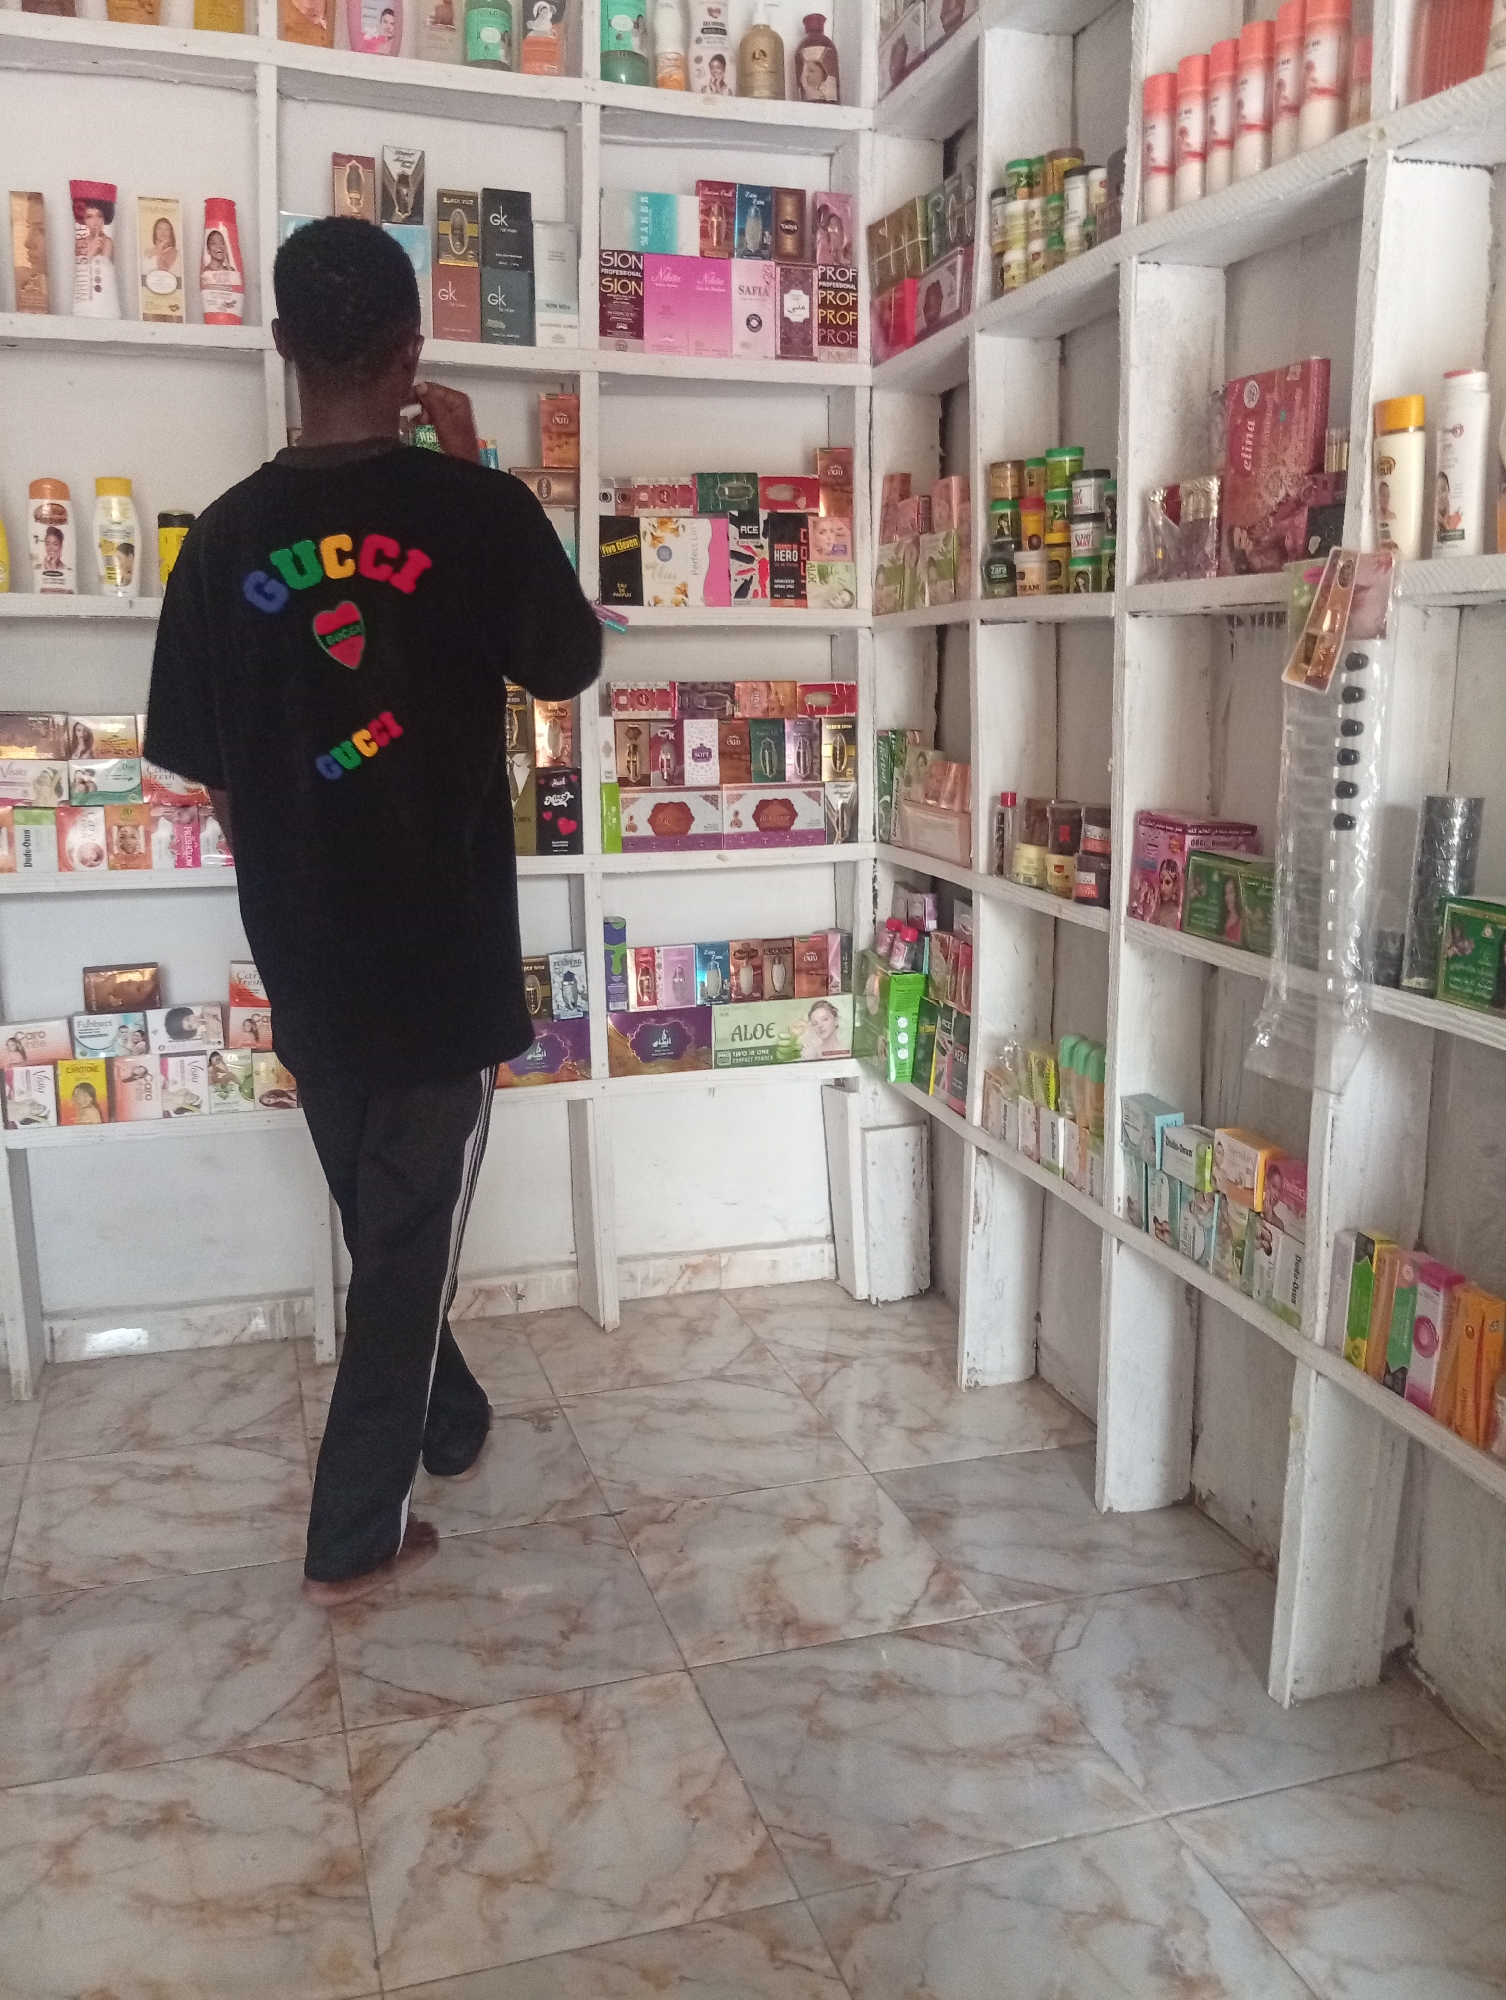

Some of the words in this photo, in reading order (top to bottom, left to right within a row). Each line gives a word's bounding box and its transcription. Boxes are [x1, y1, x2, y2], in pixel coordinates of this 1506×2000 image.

[600, 251, 643, 271] SION
[818, 265, 858, 281] PROF
[600, 278, 643, 296] SION
[738, 285, 769, 297] SAFIA
[818, 290, 858, 306] PROF
[818, 309, 858, 326] PROF
[818, 328, 858, 345] PROF
[740, 525, 759, 534] ACE
[601, 545, 617, 555] Five
[616, 538, 639, 551] Eleven
[773, 549, 799, 562] HERO
[242, 533, 433, 614] GUCCI
[314, 711, 404, 780] GUCCI
[23, 829, 33, 868] Dudu-Osun
[731, 1022, 776, 1043] ALOE
[1290, 1254, 1302, 1305] Dudu-Osun
